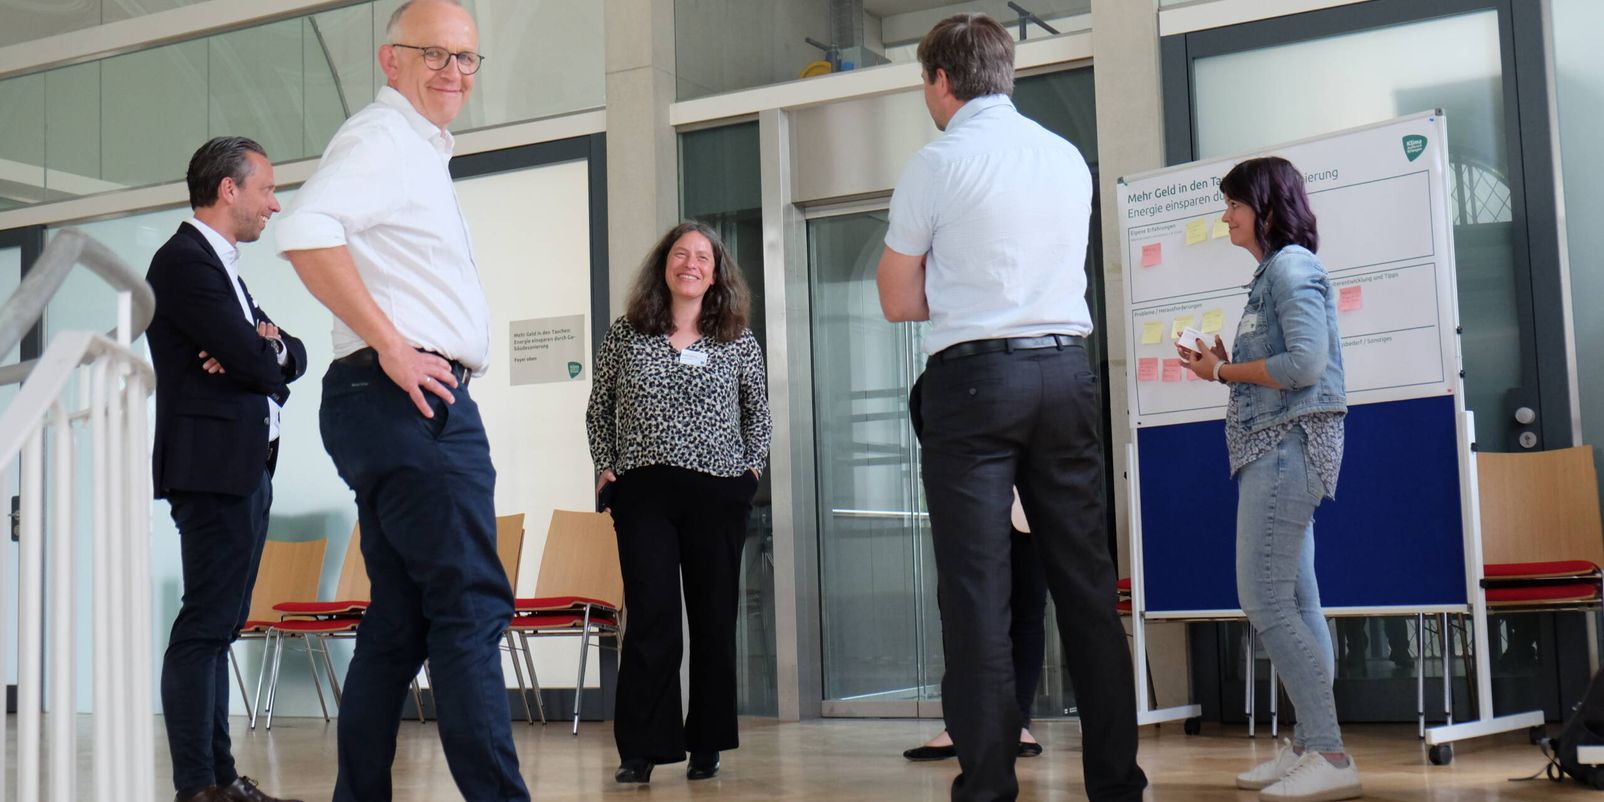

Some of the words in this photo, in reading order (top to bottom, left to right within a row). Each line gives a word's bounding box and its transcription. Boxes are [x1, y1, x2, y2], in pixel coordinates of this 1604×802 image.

[1128, 192, 1152, 203] Mehr
[1154, 185, 1176, 198] Geld
[1178, 184, 1188, 195] in
[1190, 181, 1208, 193] den
[1210, 177, 1224, 186] Ta
[1128, 205, 1162, 218] Energie
[1166, 195, 1210, 209] einsparen
[1304, 169, 1338, 182] ierung
